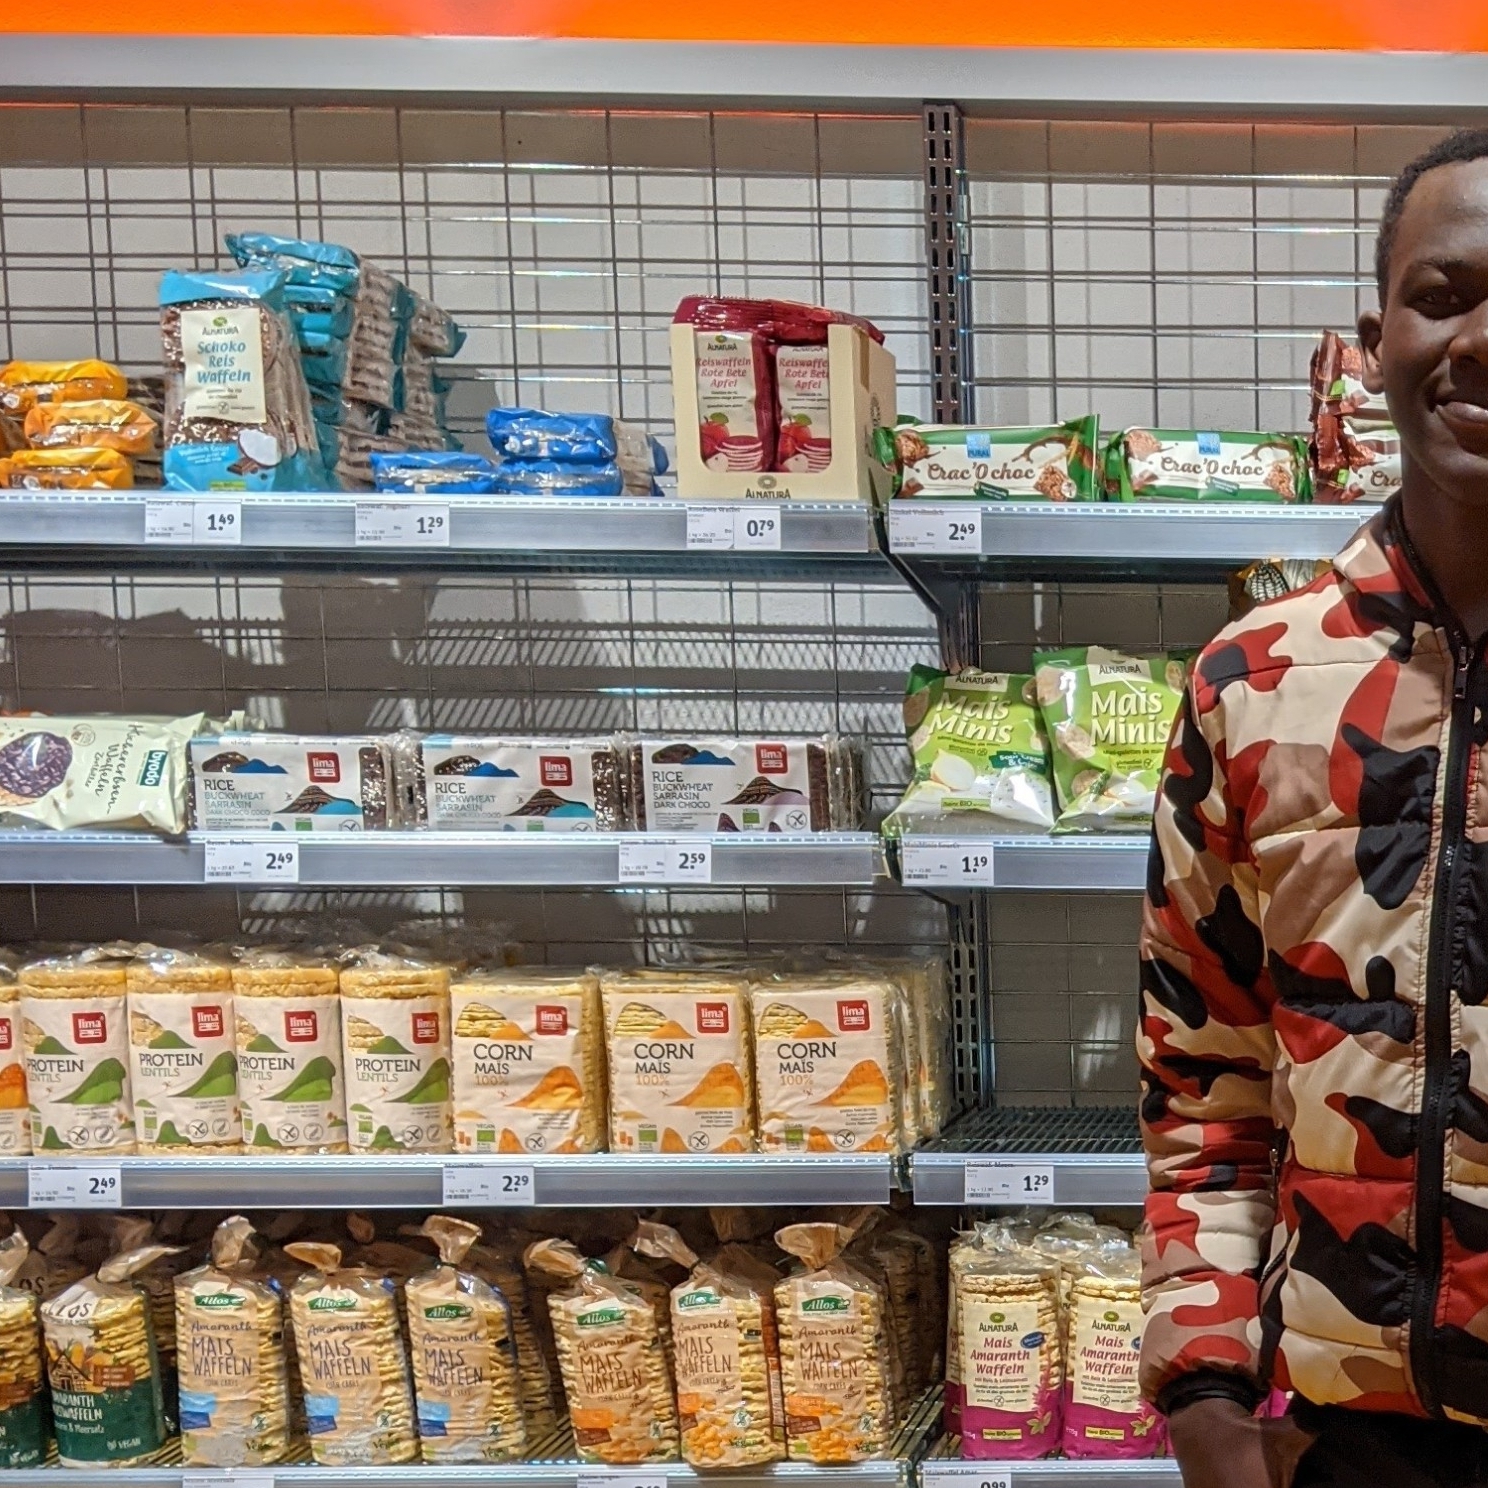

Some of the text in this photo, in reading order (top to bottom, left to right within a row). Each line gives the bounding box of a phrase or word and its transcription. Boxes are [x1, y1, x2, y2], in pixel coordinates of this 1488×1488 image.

[196, 341, 246, 355] Schoko
[208, 356, 235, 368] Reis
[196, 370, 251, 384] Waffeln
[701, 367, 747, 377] Rote Bete
[711, 378, 737, 387] Apfel
[991, 464, 1035, 480] choc
[1222, 460, 1264, 476] choc
[746, 489, 790, 499] ALNATURA
[1100, 664, 1141, 675] ALNATURA
[936, 694, 1010, 720] Mais
[928, 714, 1013, 743] Minis
[761, 750, 782, 759] lima
[140, 750, 166, 786] byodo
[652, 771, 683, 782] RICE
[204, 780, 234, 791] RICE
[653, 783, 712, 792] BUCKWHEAT
[654, 801, 710, 809] DARK CHOCO
[197, 1011, 220, 1022] lima
[842, 1007, 864, 1017] lima
[474, 1044, 533, 1061] CORN
[777, 1042, 836, 1058] CORN
[139, 1053, 203, 1066] PROTEIN
[474, 1060, 510, 1074] MAÏS
[779, 1059, 814, 1074] MAÏS
[636, 1075, 670, 1086] 100%
[806, 1298, 835, 1310] Allos
[979, 1323, 1018, 1332] ALNATURA
[192, 1338, 233, 1358] MAIS
[984, 1337, 1012, 1348] Mais
[801, 1343, 841, 1361] MAIS
[970, 1349, 1030, 1361] Amaranth
[193, 1356, 252, 1376] WAFFELN
[801, 1361, 858, 1379] WAFFELN
[976, 1363, 1024, 1375] Waffeln
